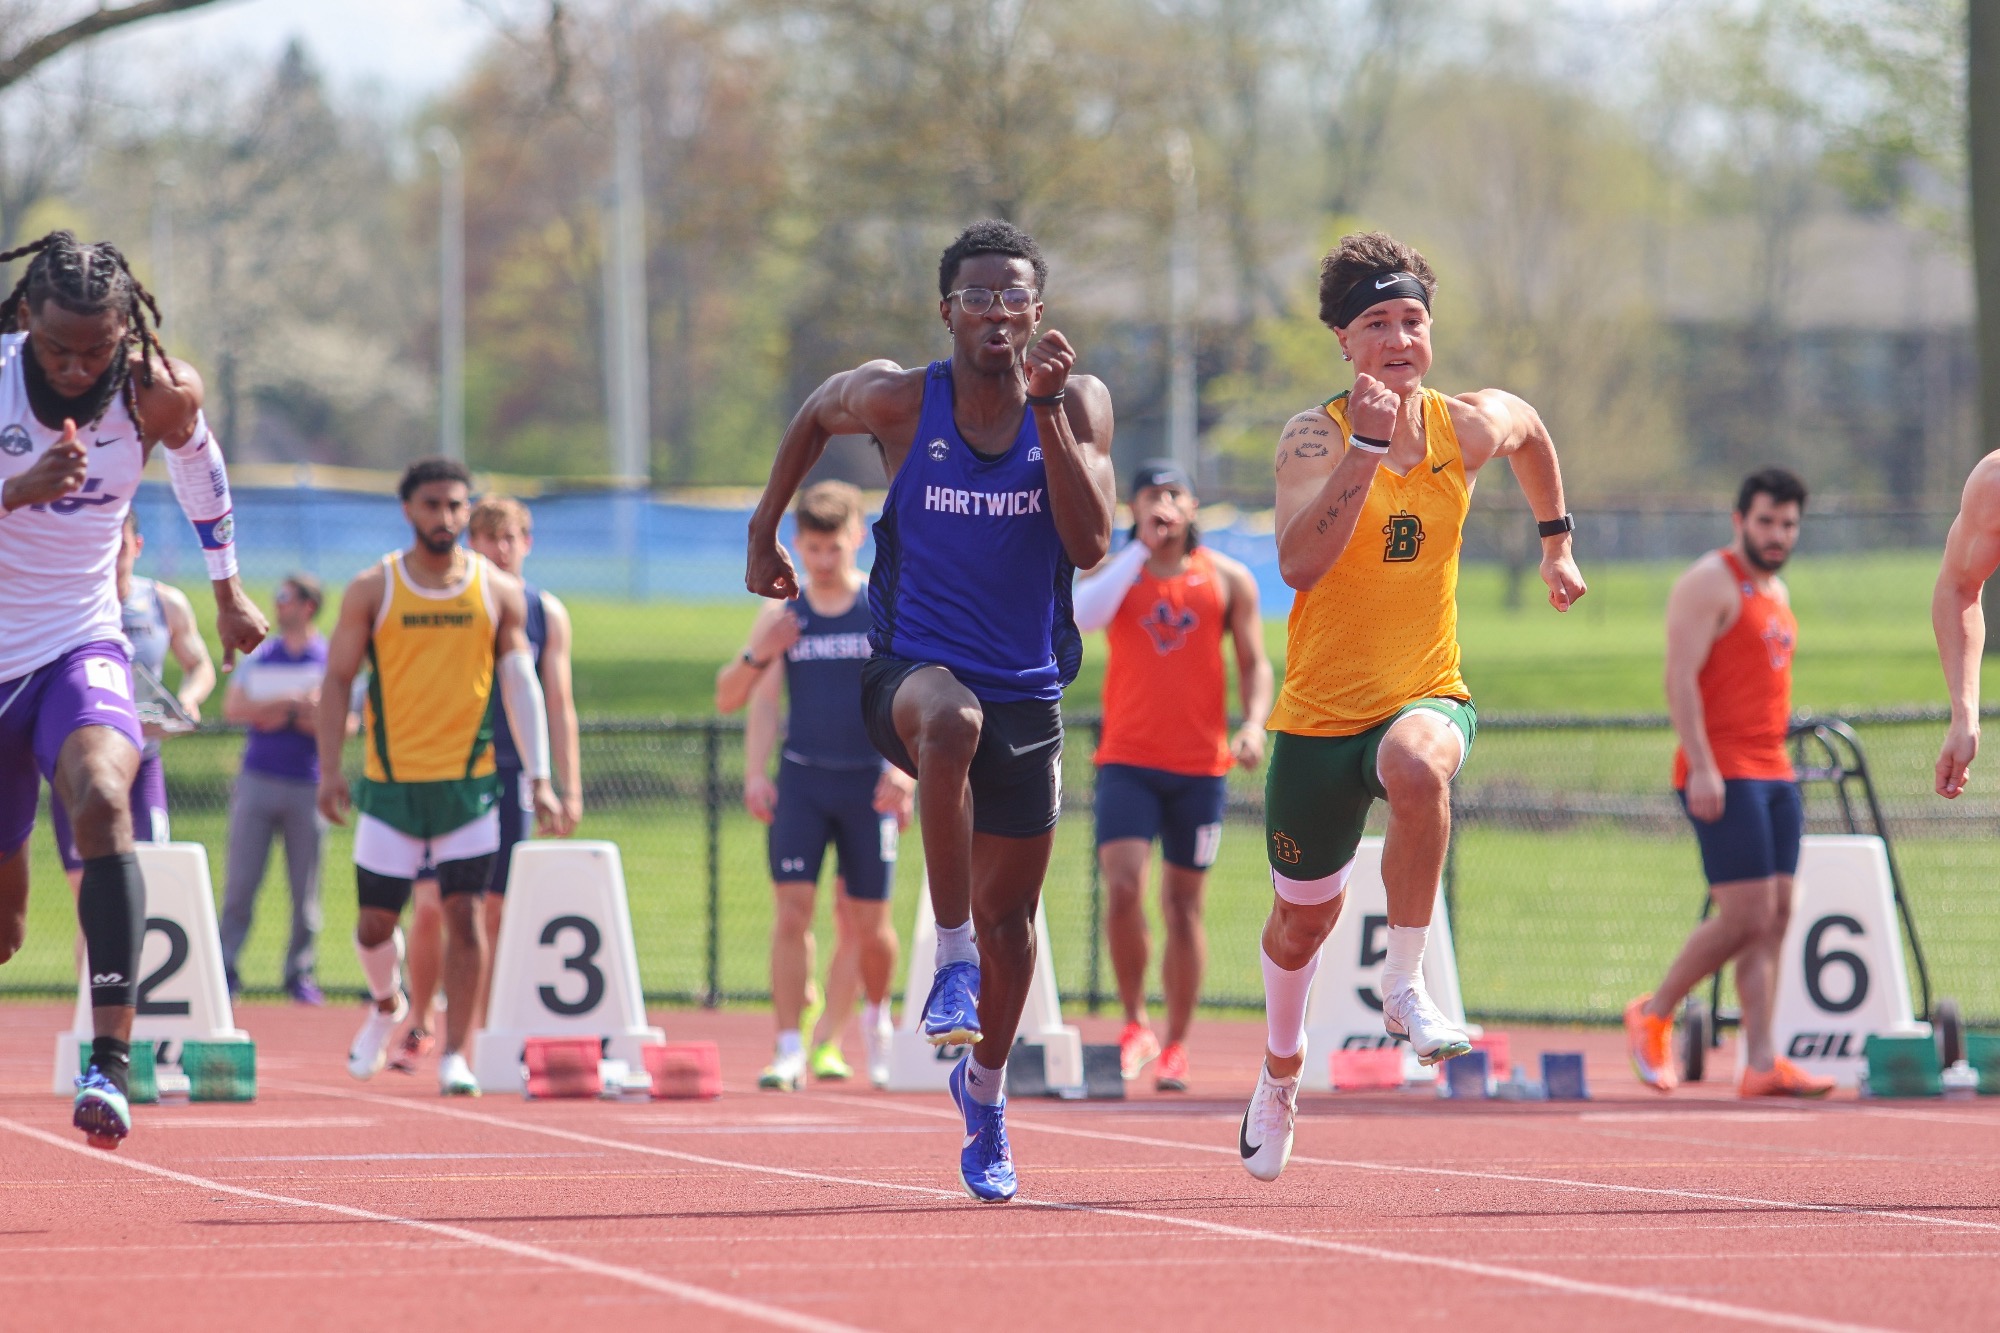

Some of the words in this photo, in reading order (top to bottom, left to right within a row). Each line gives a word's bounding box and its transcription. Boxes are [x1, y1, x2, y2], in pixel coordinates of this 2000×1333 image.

[925, 485, 1043, 517] HARTWICK
[1382, 509, 1426, 563] B
[135, 917, 189, 1015] 2
[538, 915, 604, 1016] 3
[1804, 915, 1869, 1013] 6
